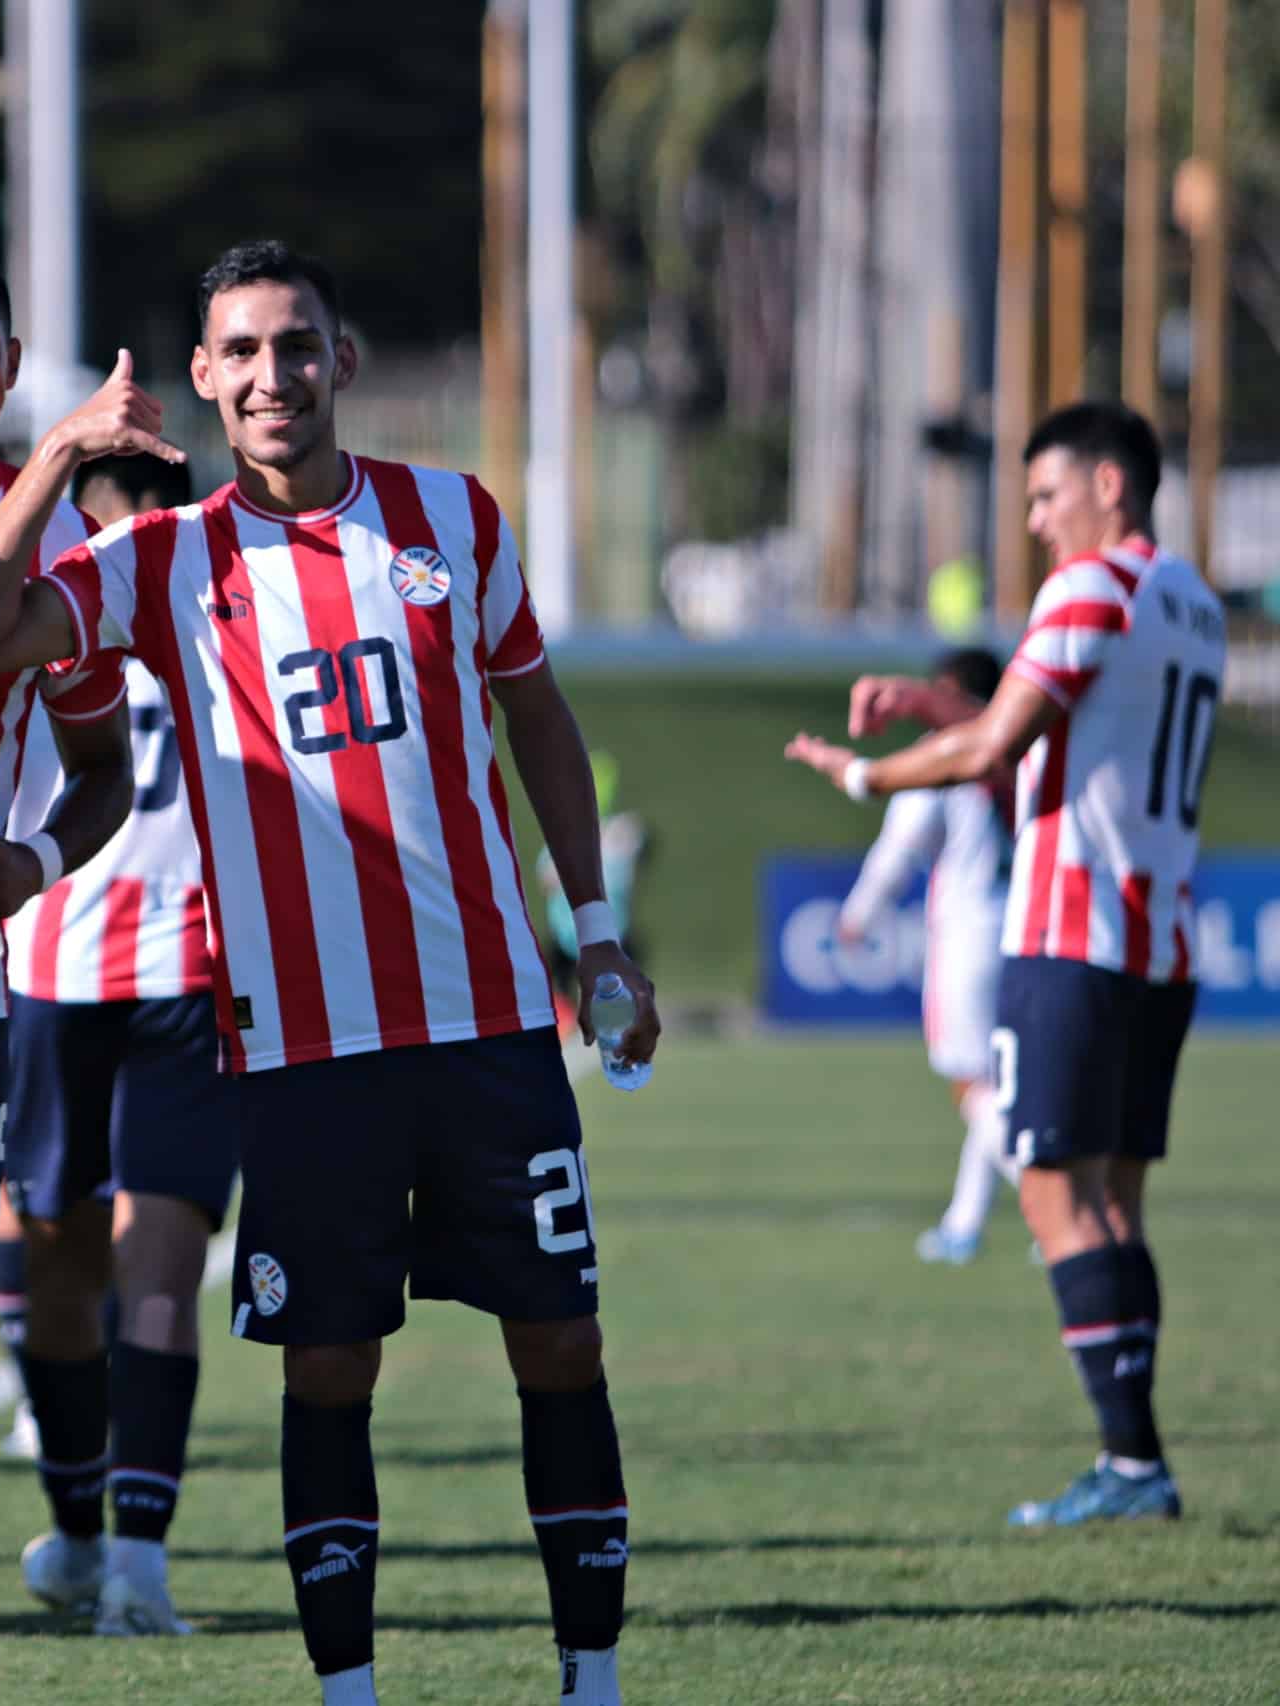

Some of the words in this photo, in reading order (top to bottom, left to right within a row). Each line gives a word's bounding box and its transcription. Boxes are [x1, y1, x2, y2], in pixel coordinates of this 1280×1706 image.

[277, 636, 408, 755] 20
[1146, 660, 1218, 830] 10
[528, 1146, 597, 1254] 2
[301, 1556, 350, 1585] PUMA
